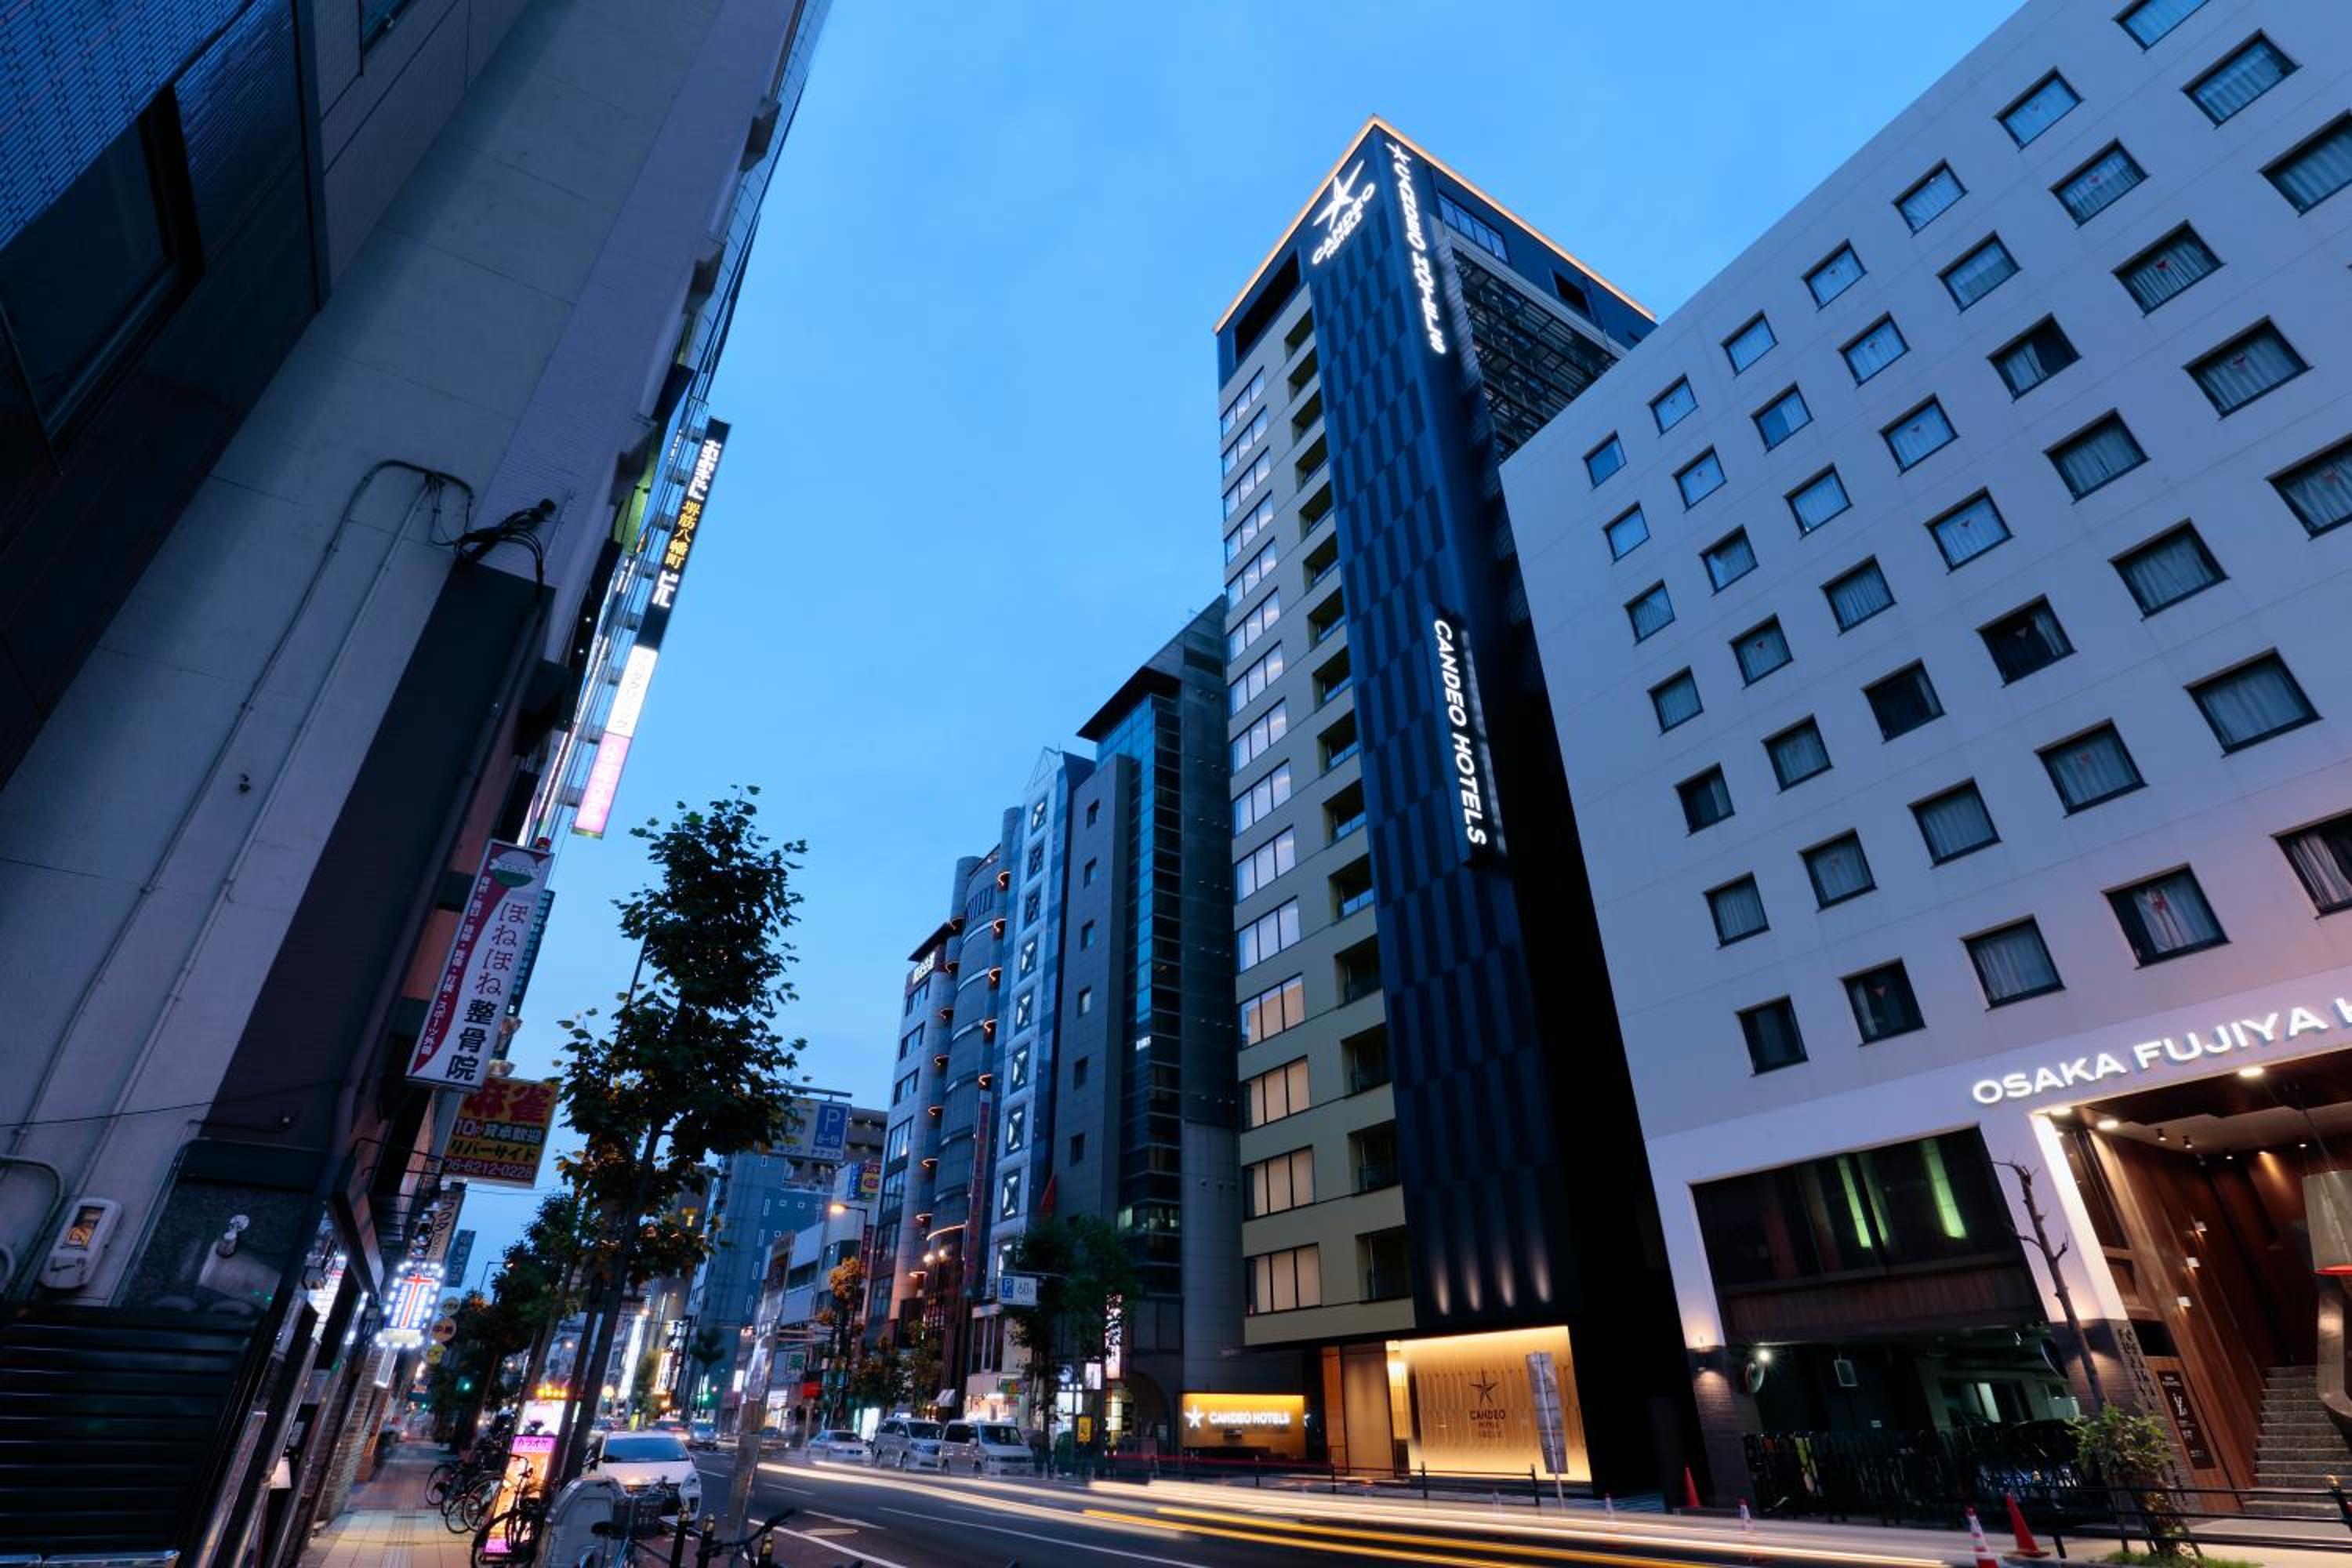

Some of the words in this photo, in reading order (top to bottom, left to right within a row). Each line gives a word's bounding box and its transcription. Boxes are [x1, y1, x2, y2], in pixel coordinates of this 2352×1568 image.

[1312, 182, 1375, 265] CANDEO
[1394, 162, 1425, 251] CANDEO
[1413, 251, 1446, 354] HOTELS
[1434, 619, 1467, 727] CANDEO
[1452, 731, 1487, 846] HOTELS
[445, 902, 529, 1081] ほねほね整骨院
[1972, 1052, 2127, 1105] OSAKA
[2133, 1006, 2328, 1069] FUJIYA
[825, 1108, 840, 1132] P
[1208, 1411, 1252, 1425] CANDEO
[1253, 1411, 1291, 1425] HOTELS
[1469, 1409, 1506, 1421] CANDEO
